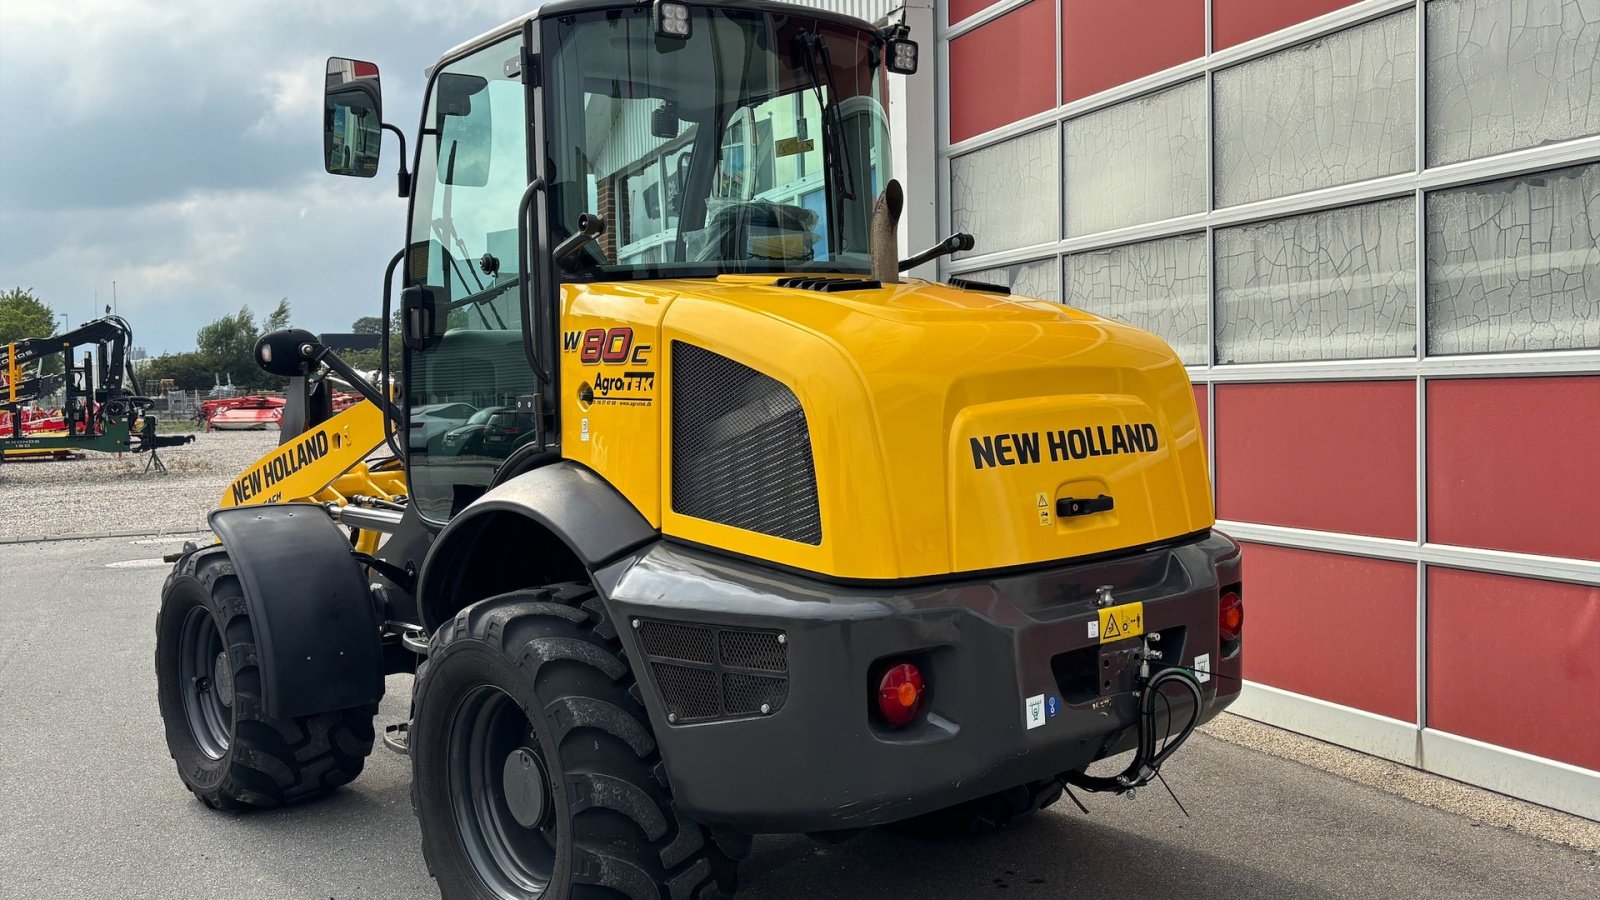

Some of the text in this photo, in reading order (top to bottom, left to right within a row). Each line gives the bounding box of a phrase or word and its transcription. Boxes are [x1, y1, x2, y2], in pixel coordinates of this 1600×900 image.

[594, 371, 655, 396] AgroTEK
[231, 429, 329, 506] NEW HOLLAND
[969, 423, 1159, 470] NEW HOLLAND
